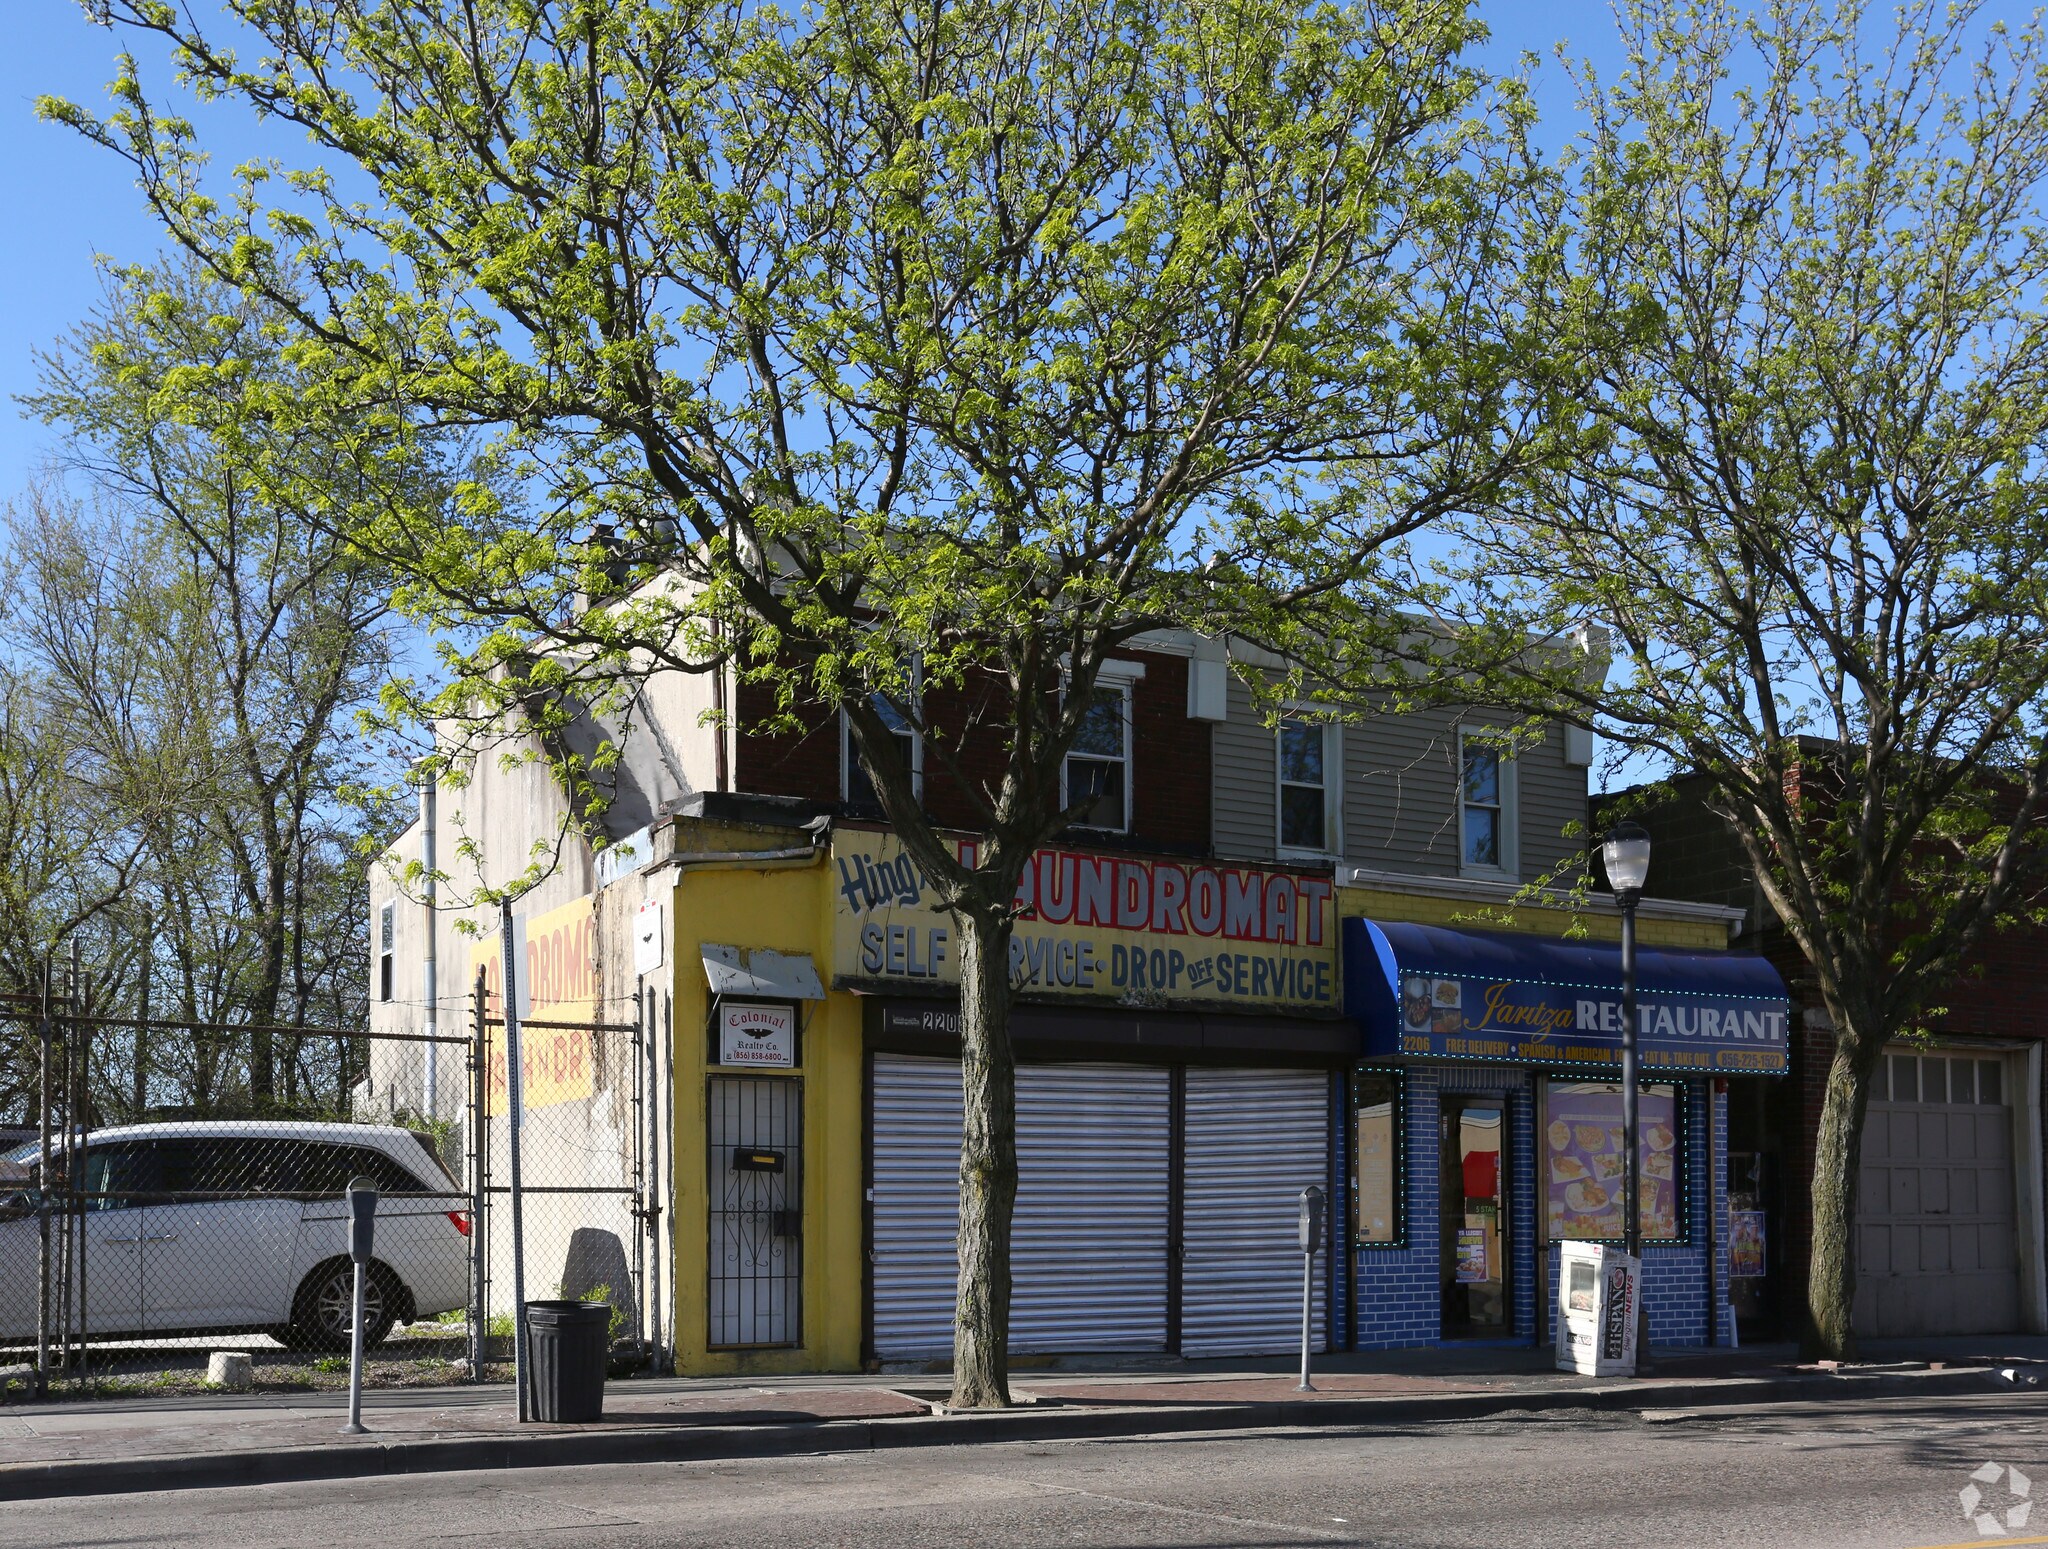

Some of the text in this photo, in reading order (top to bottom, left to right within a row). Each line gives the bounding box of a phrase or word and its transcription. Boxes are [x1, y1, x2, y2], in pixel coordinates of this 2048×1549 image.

[861, 922, 1331, 1001] SELF RVICE DROP OFF SERVICE
[729, 1011, 786, 1029] Colonial
[1463, 981, 1574, 1045] Jaritza
[737, 1040, 779, 1051] Realty Co.
[1403, 1036, 1431, 1052] 2206
[1446, 1038, 1467, 1053] FREE
[1468, 1040, 1509, 1056] DELIVERY
[1518, 1043, 1556, 1059] SPANISH
[1565, 1046, 1611, 1062] AMERICAN
[1644, 1050, 1660, 1064] EAT
[1673, 1051, 1693, 1066] TAKE
[1694, 1053, 1710, 1066] OUT
[1721, 1052, 1780, 1068] 856-225-1527
[733, 1051, 750, 1060] (856)
[751, 1052, 782, 1061] 858-6800
